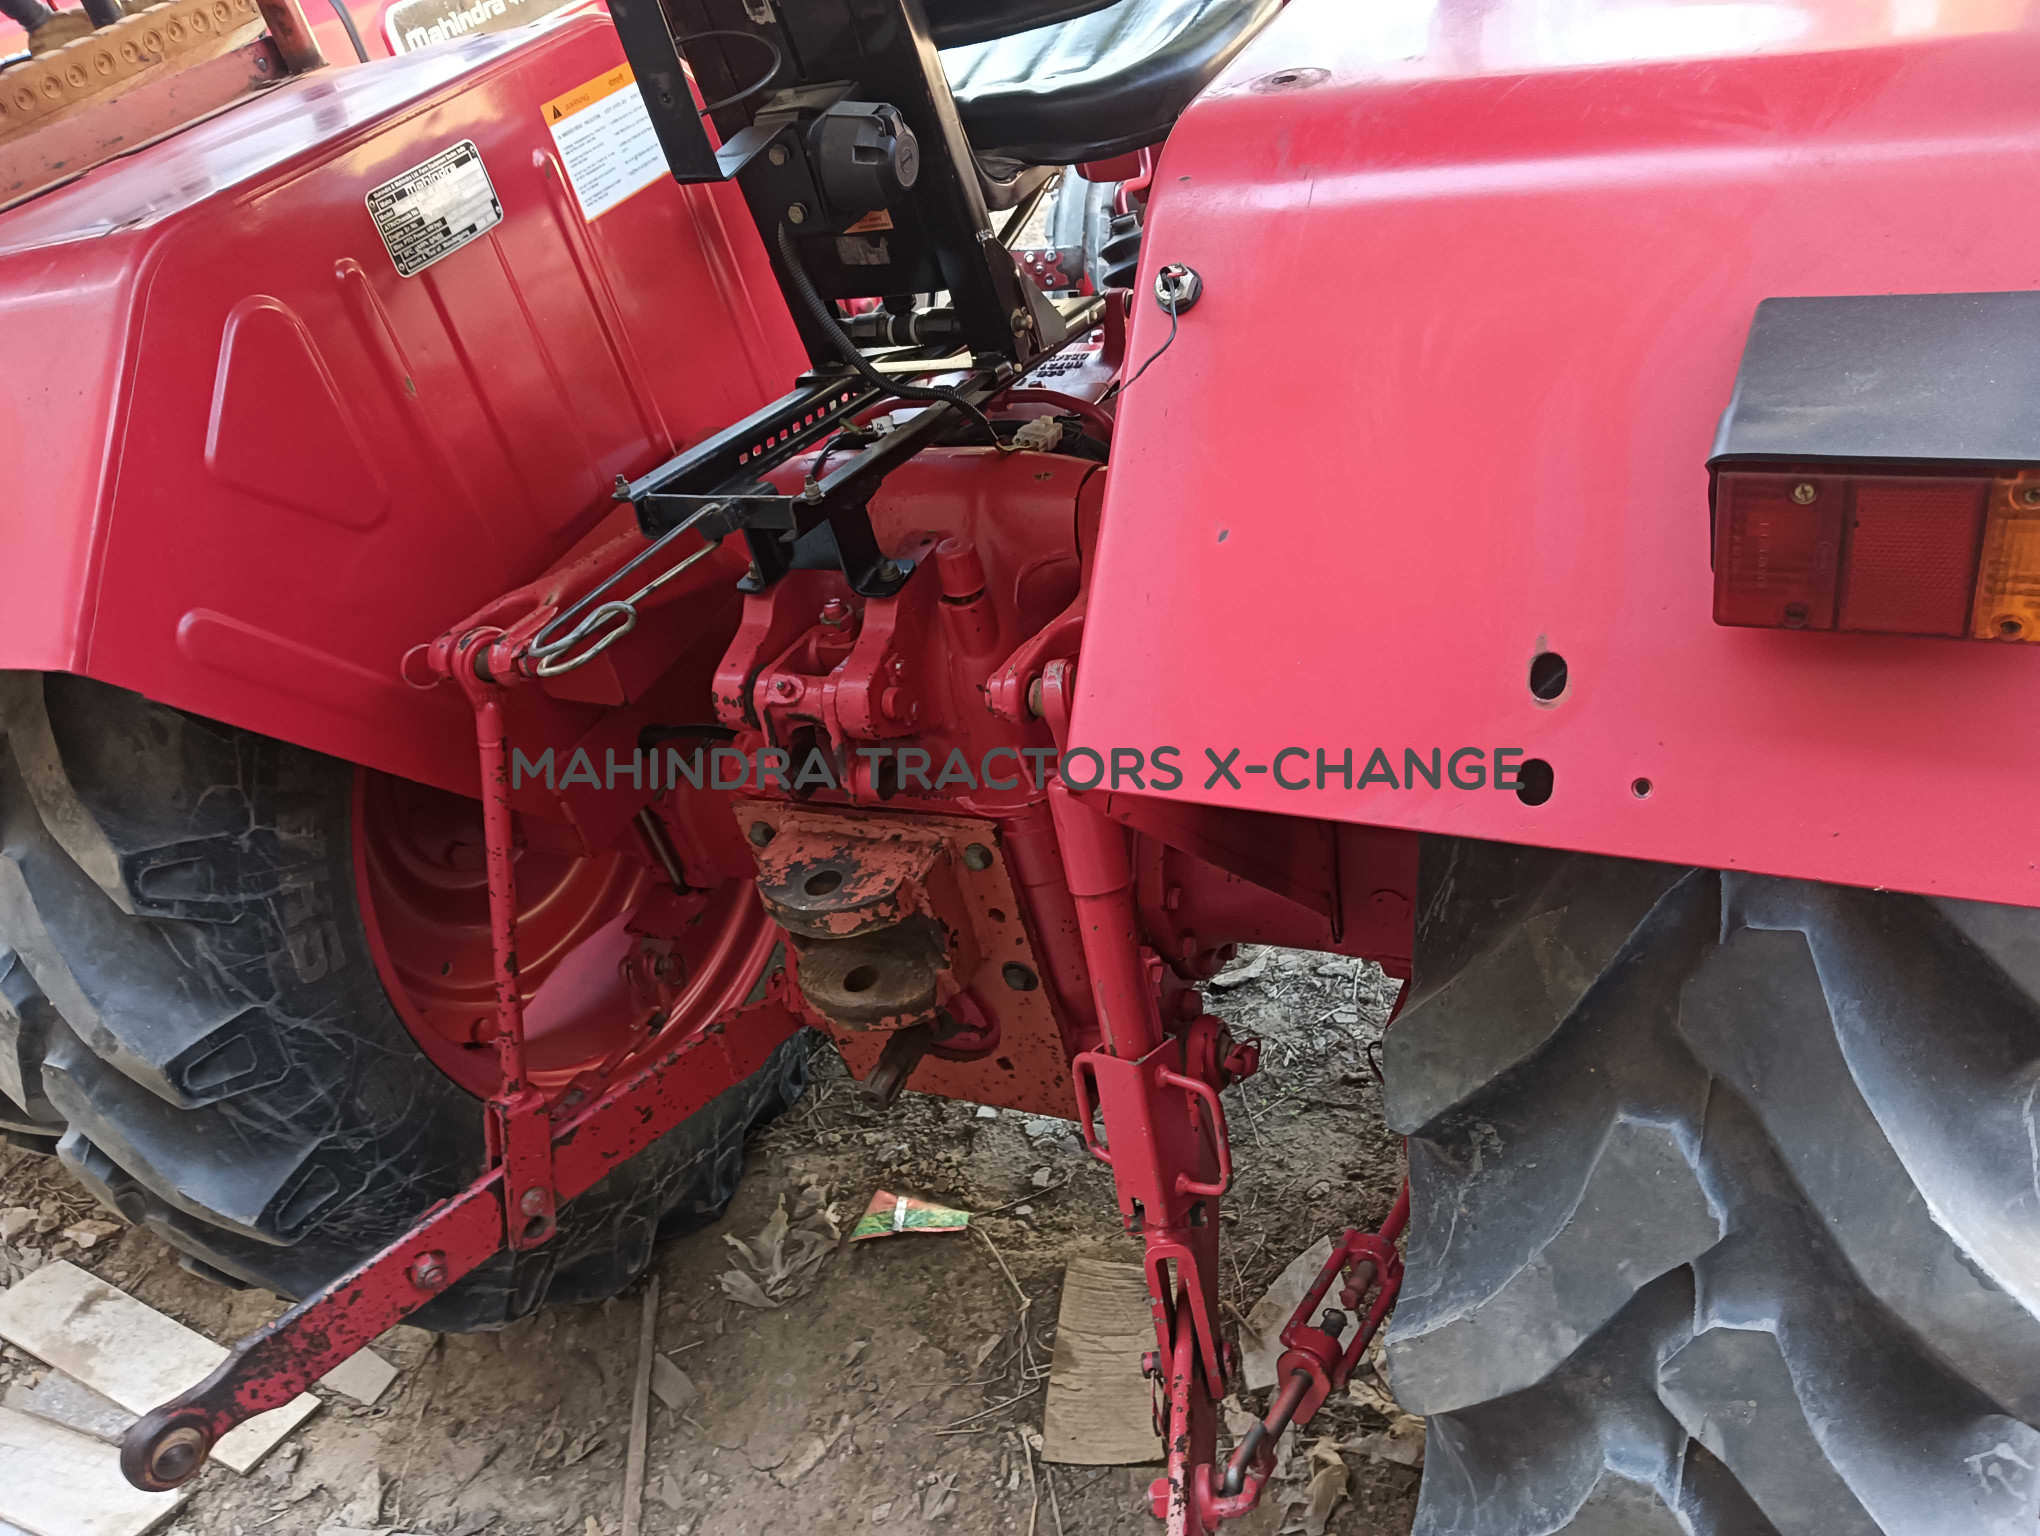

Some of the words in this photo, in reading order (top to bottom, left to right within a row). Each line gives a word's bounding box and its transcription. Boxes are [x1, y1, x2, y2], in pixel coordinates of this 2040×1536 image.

[379, 197, 393, 208] Make
[378, 209, 393, 221] Model
[403, 235, 414, 245] PTO
